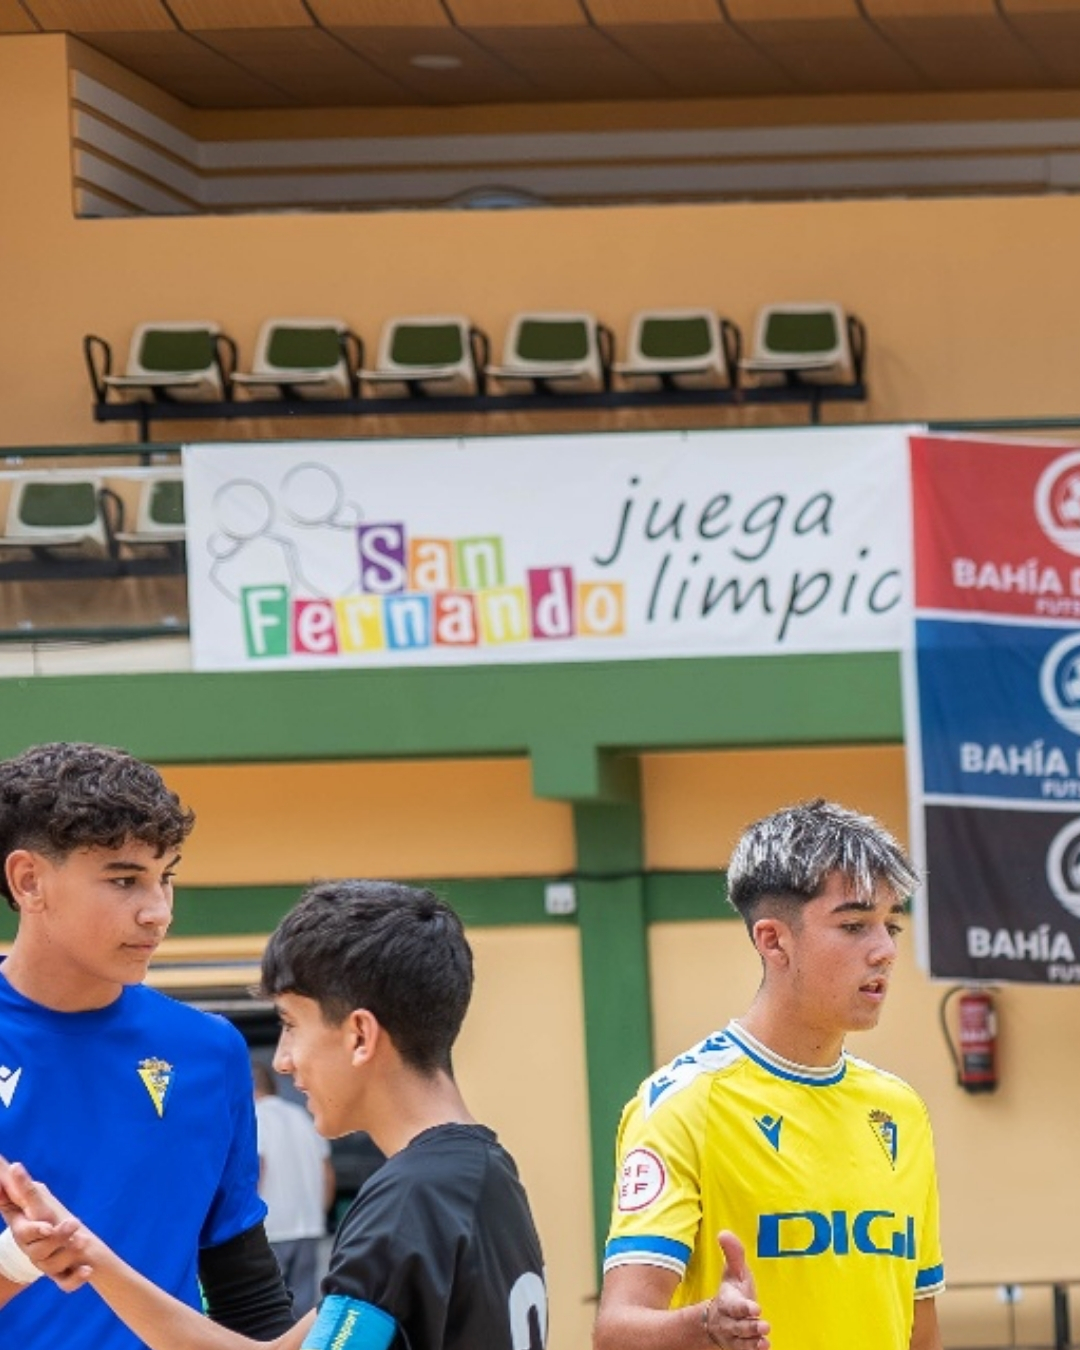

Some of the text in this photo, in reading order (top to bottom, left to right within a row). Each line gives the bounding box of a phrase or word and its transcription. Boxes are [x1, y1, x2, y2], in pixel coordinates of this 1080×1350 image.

[593, 476, 835, 567] juega
[358, 525, 503, 592] San
[953, 557, 1062, 597] BAHÍA
[244, 568, 621, 656] Fernando
[960, 738, 1070, 778] BAHÍA
[967, 924, 1075, 962] BAHÍA
[756, 1210, 916, 1260] DIGI
